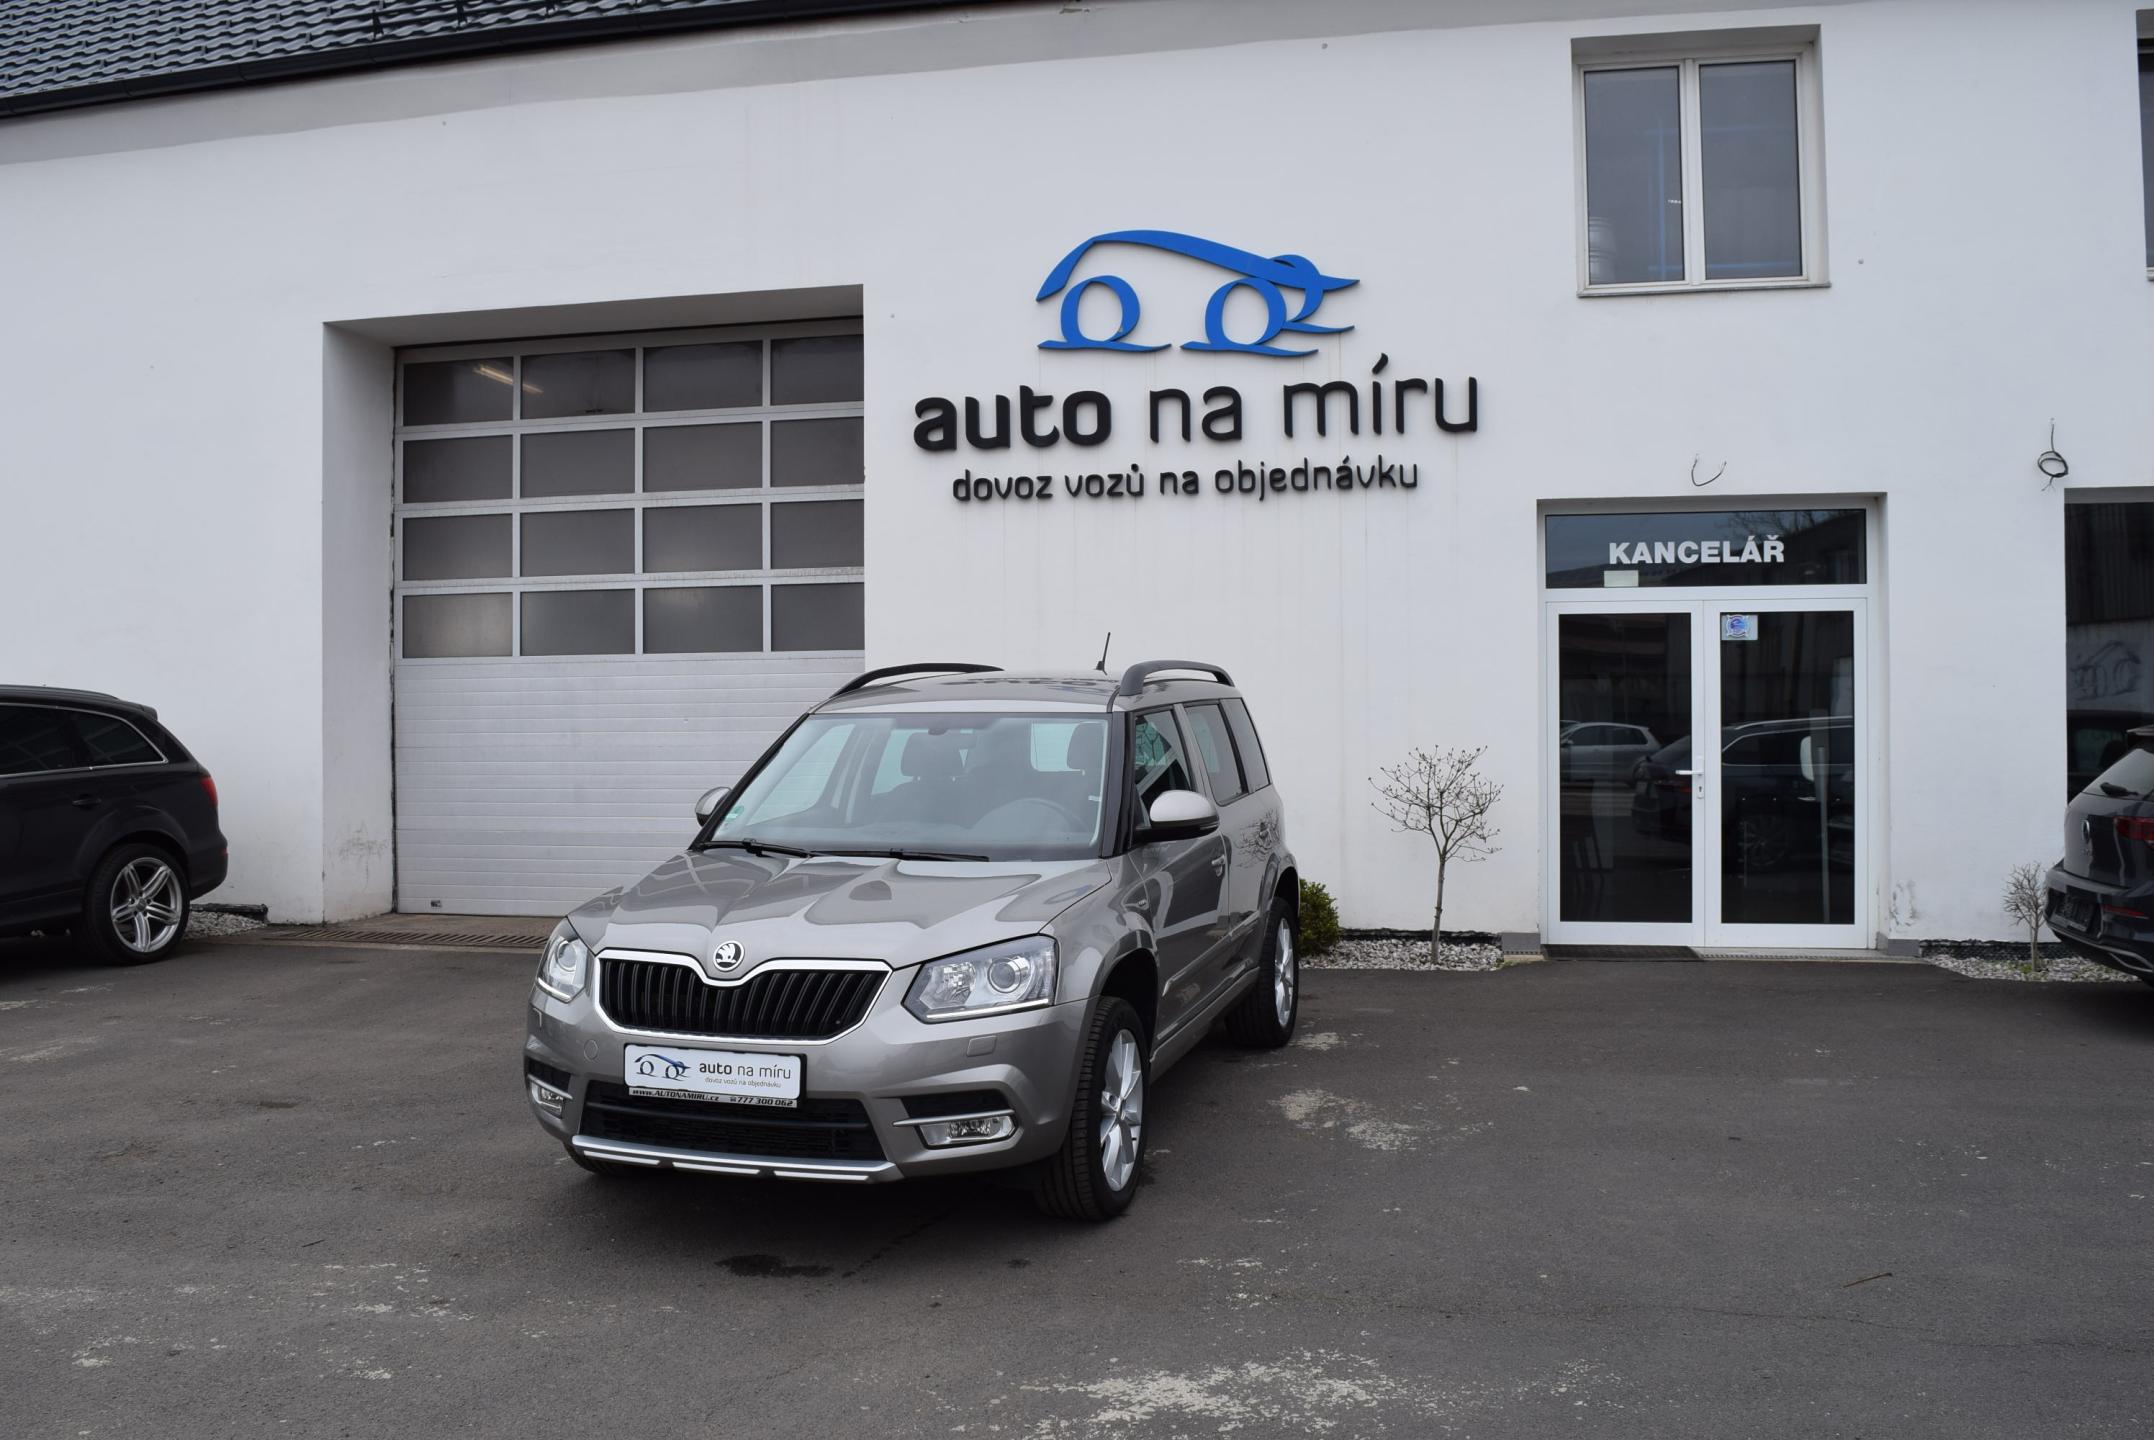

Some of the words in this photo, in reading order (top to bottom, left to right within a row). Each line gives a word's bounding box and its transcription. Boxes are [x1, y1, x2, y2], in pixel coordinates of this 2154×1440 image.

[913, 384, 1112, 452] auto
[1149, 385, 1243, 444] na
[1283, 352, 1478, 438] míru
[952, 469, 1054, 502] dovoz
[1064, 463, 1144, 498] vozů
[1159, 469, 1200, 495] na
[1214, 455, 1418, 501] objednávku
[1609, 534, 1785, 565] KANCELÁŘ
[699, 1062, 733, 1075] auto
[737, 1065, 754, 1077] na
[759, 1064, 791, 1080] míru
